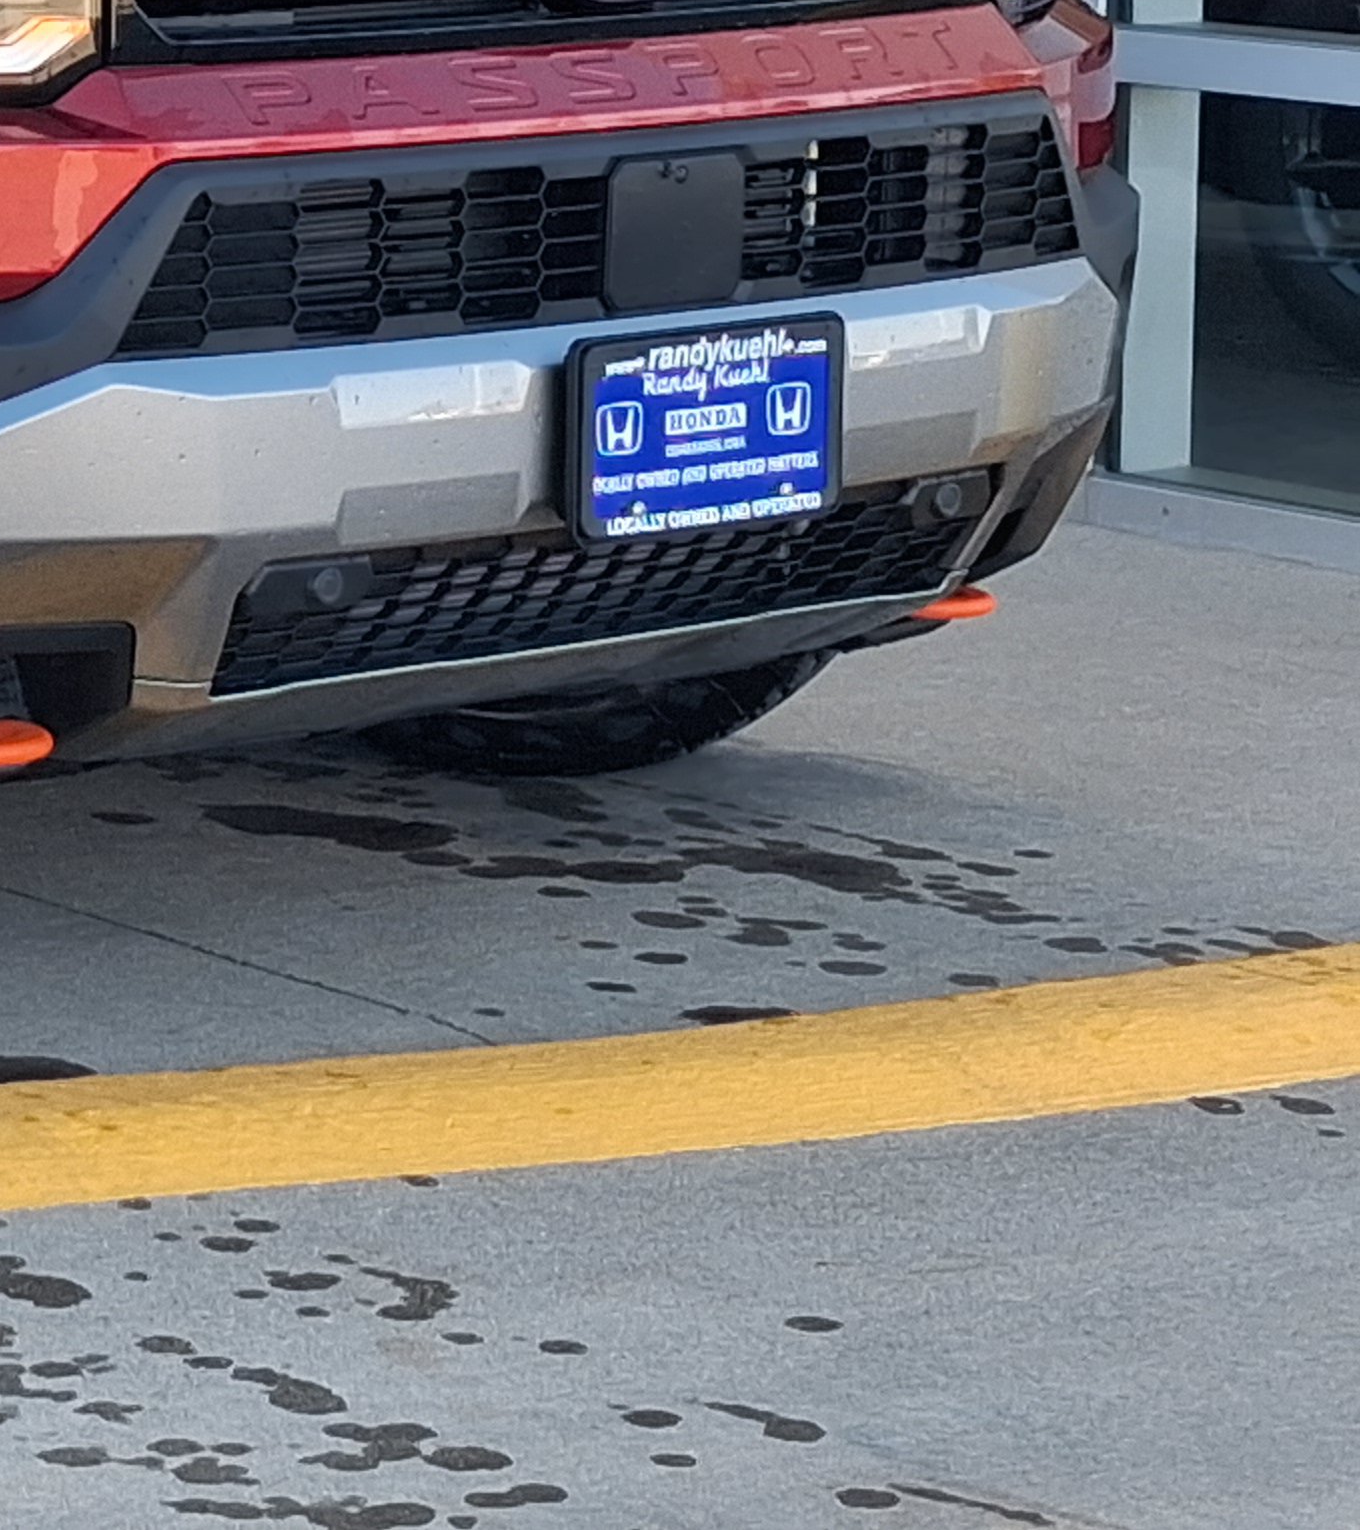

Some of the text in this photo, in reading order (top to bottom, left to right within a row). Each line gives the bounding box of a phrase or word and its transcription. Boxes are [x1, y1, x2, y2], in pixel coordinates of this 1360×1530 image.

[222, 22, 970, 126] PASSPORT
[642, 368, 708, 402] Randy
[714, 358, 770, 388] Kuehl
[669, 407, 742, 430] HONDA
[606, 513, 666, 536] LOCALLY
